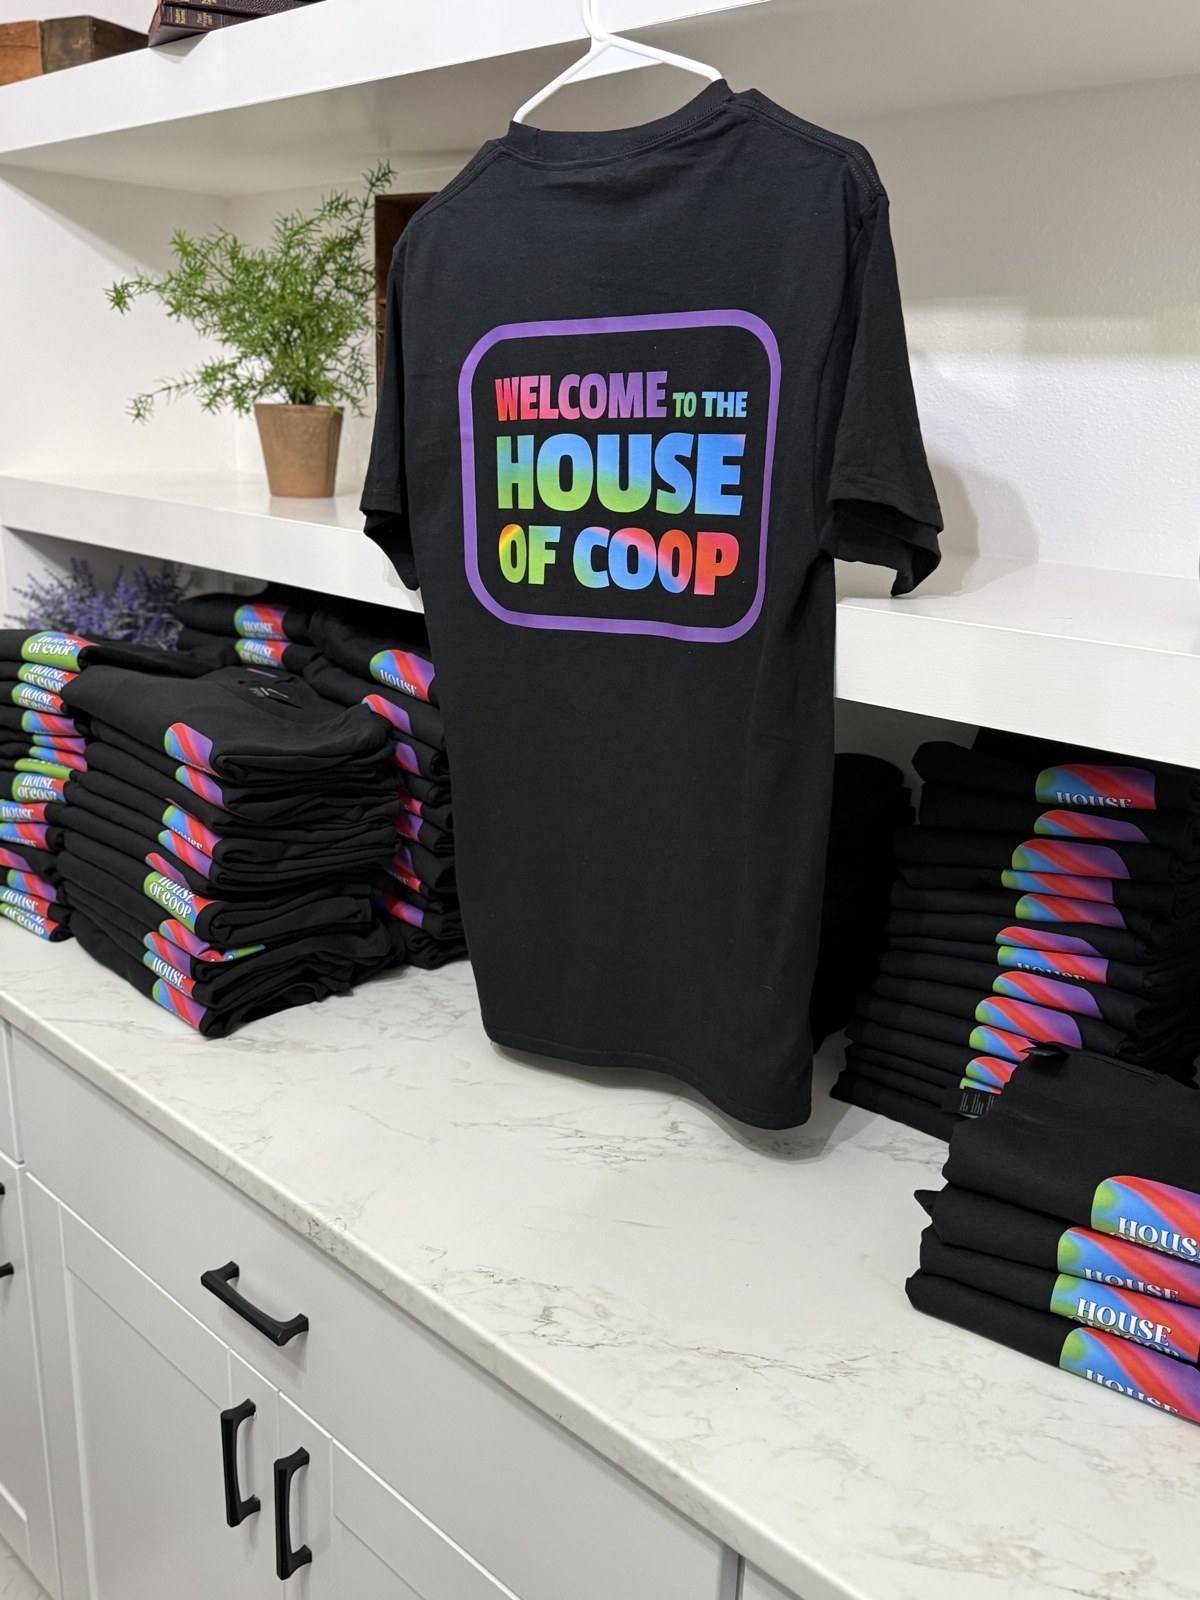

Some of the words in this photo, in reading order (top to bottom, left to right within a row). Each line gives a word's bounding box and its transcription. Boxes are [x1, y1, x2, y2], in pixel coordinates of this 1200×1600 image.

[494, 370, 668, 422] WELCOME
[672, 391, 697, 418] TO
[701, 391, 748, 418] THE
[496, 432, 746, 516] HOUSE
[498, 523, 561, 585] OF
[572, 526, 740, 596] COOP
[27, 642, 45, 654] OF
[42, 643, 75, 656] COOP
[30, 664, 68, 681] HOUSE
[21, 687, 55, 706] HOUSE
[22, 775, 55, 790] HOUSE
[2, 806, 34, 820] HOUSE
[2, 889, 38, 912] HOUSE
[149, 882, 164, 899] OF
[162, 891, 192, 918] COOP
[153, 957, 187, 989] HOUSE
[1118, 1217, 1200, 1258] HOUS
[1077, 1298, 1172, 1347] HOUSE
